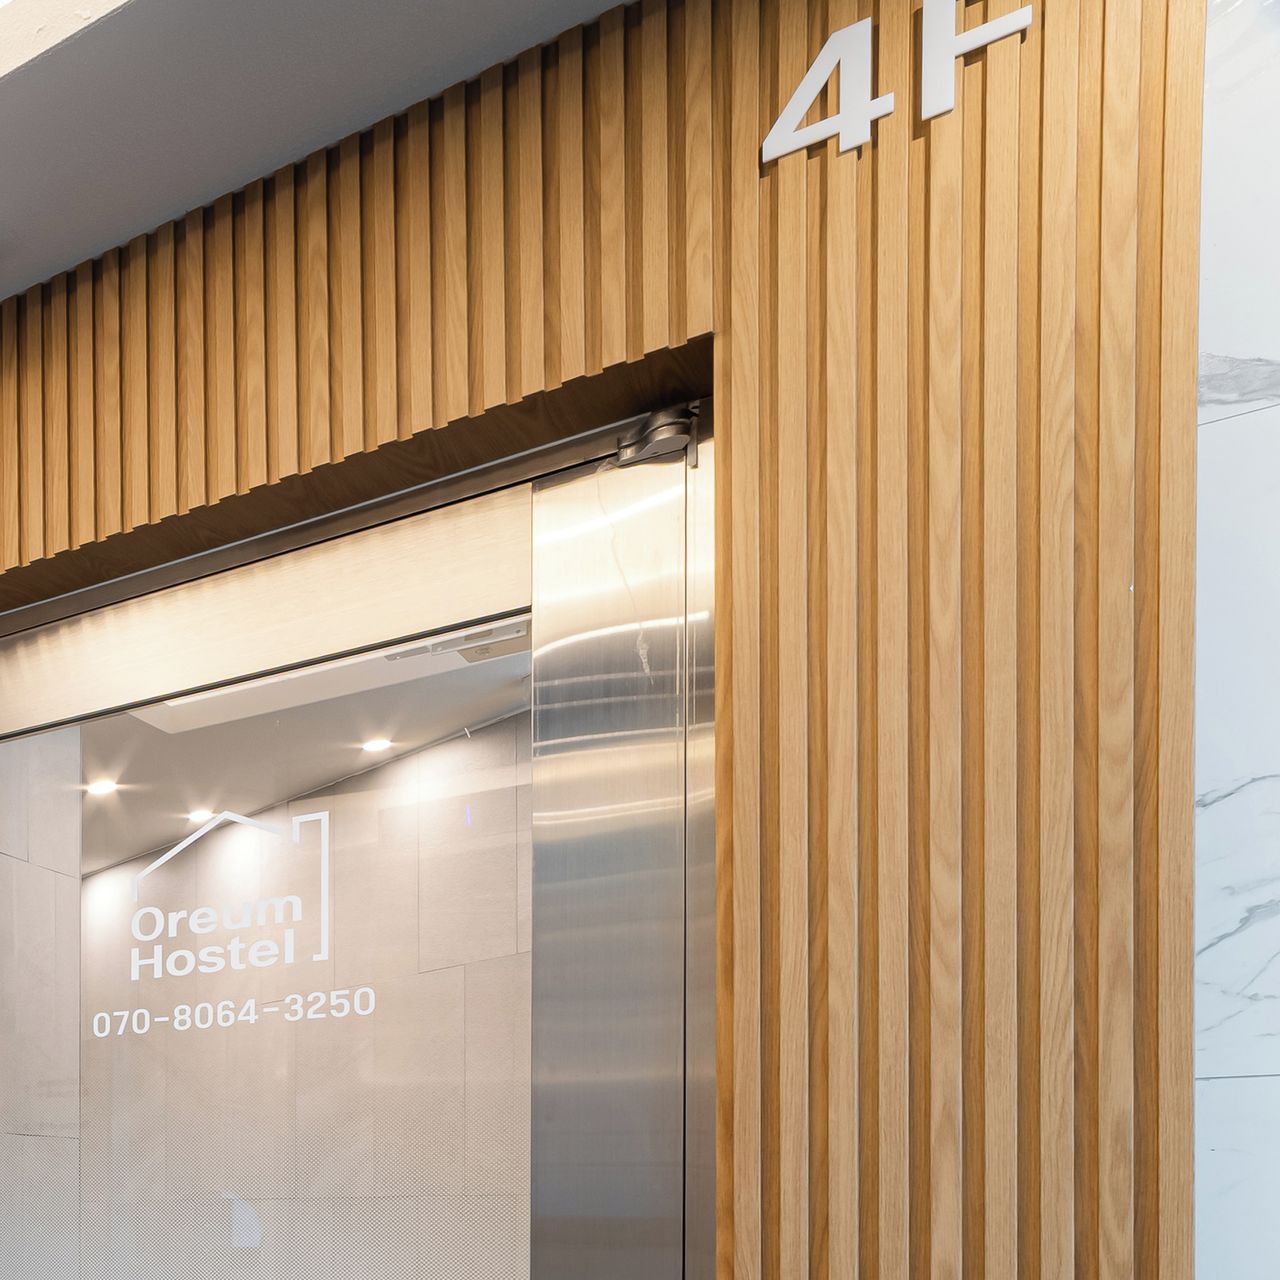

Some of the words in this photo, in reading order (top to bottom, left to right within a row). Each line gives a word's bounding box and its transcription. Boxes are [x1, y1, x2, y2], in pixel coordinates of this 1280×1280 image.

[761, 0, 1033, 163] 4F
[130, 894, 303, 942] Oreum
[130, 928, 295, 981] Hostel
[93, 987, 377, 1038] 070-8064-3250
